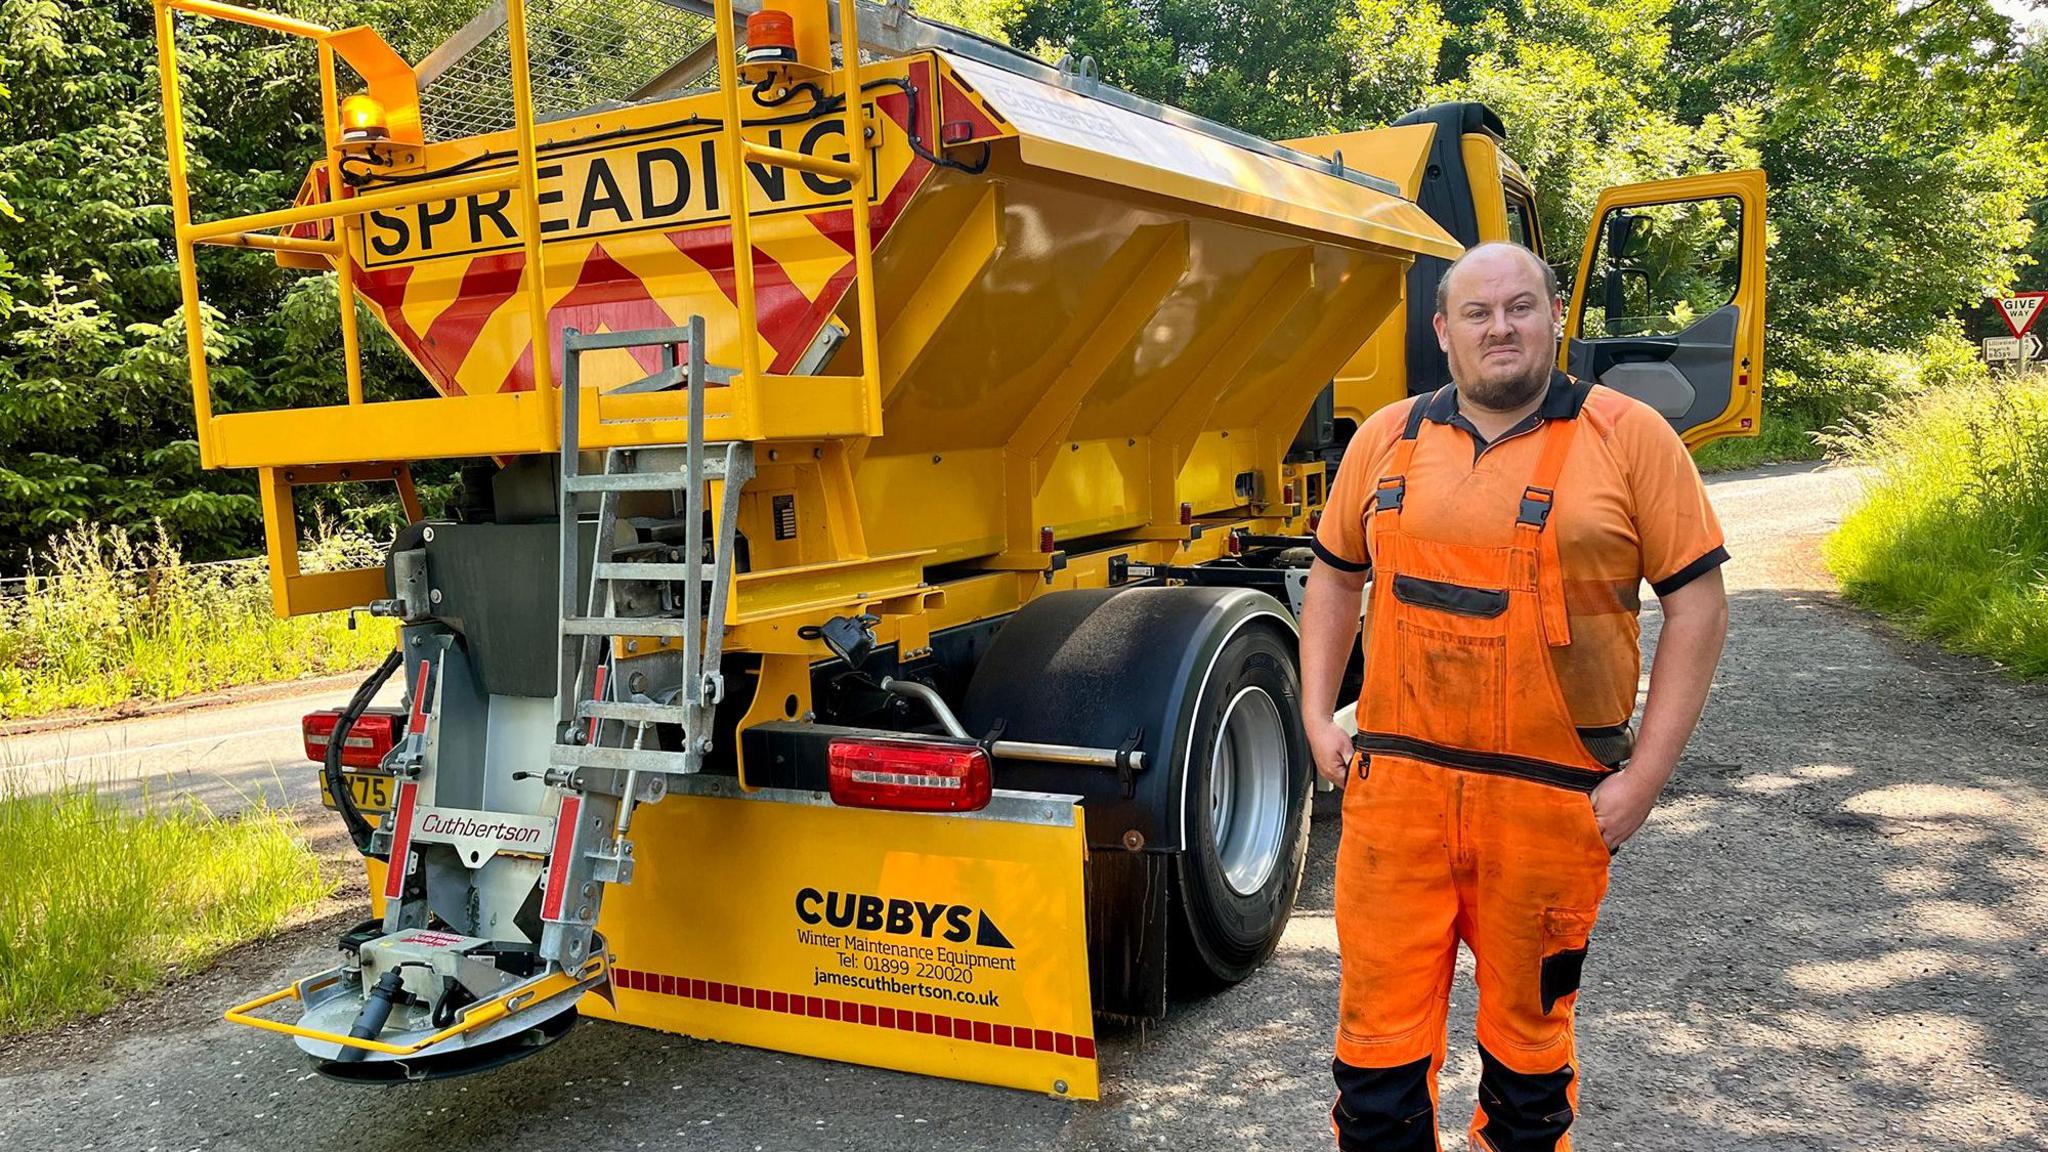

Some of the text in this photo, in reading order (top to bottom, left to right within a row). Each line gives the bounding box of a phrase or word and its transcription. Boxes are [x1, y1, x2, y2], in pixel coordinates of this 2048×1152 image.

[371, 119, 852, 256] SPREADING
[2004, 299, 2035, 309] GIVE
[422, 814, 541, 843] Cuthbertson
[796, 887, 973, 943] CUBBYS
[797, 929, 1016, 971] Winter Maintenance Equipment
[837, 952, 973, 984] Tel: 01899 220020
[814, 967, 999, 1007] jamescuthbertson.co.uk
